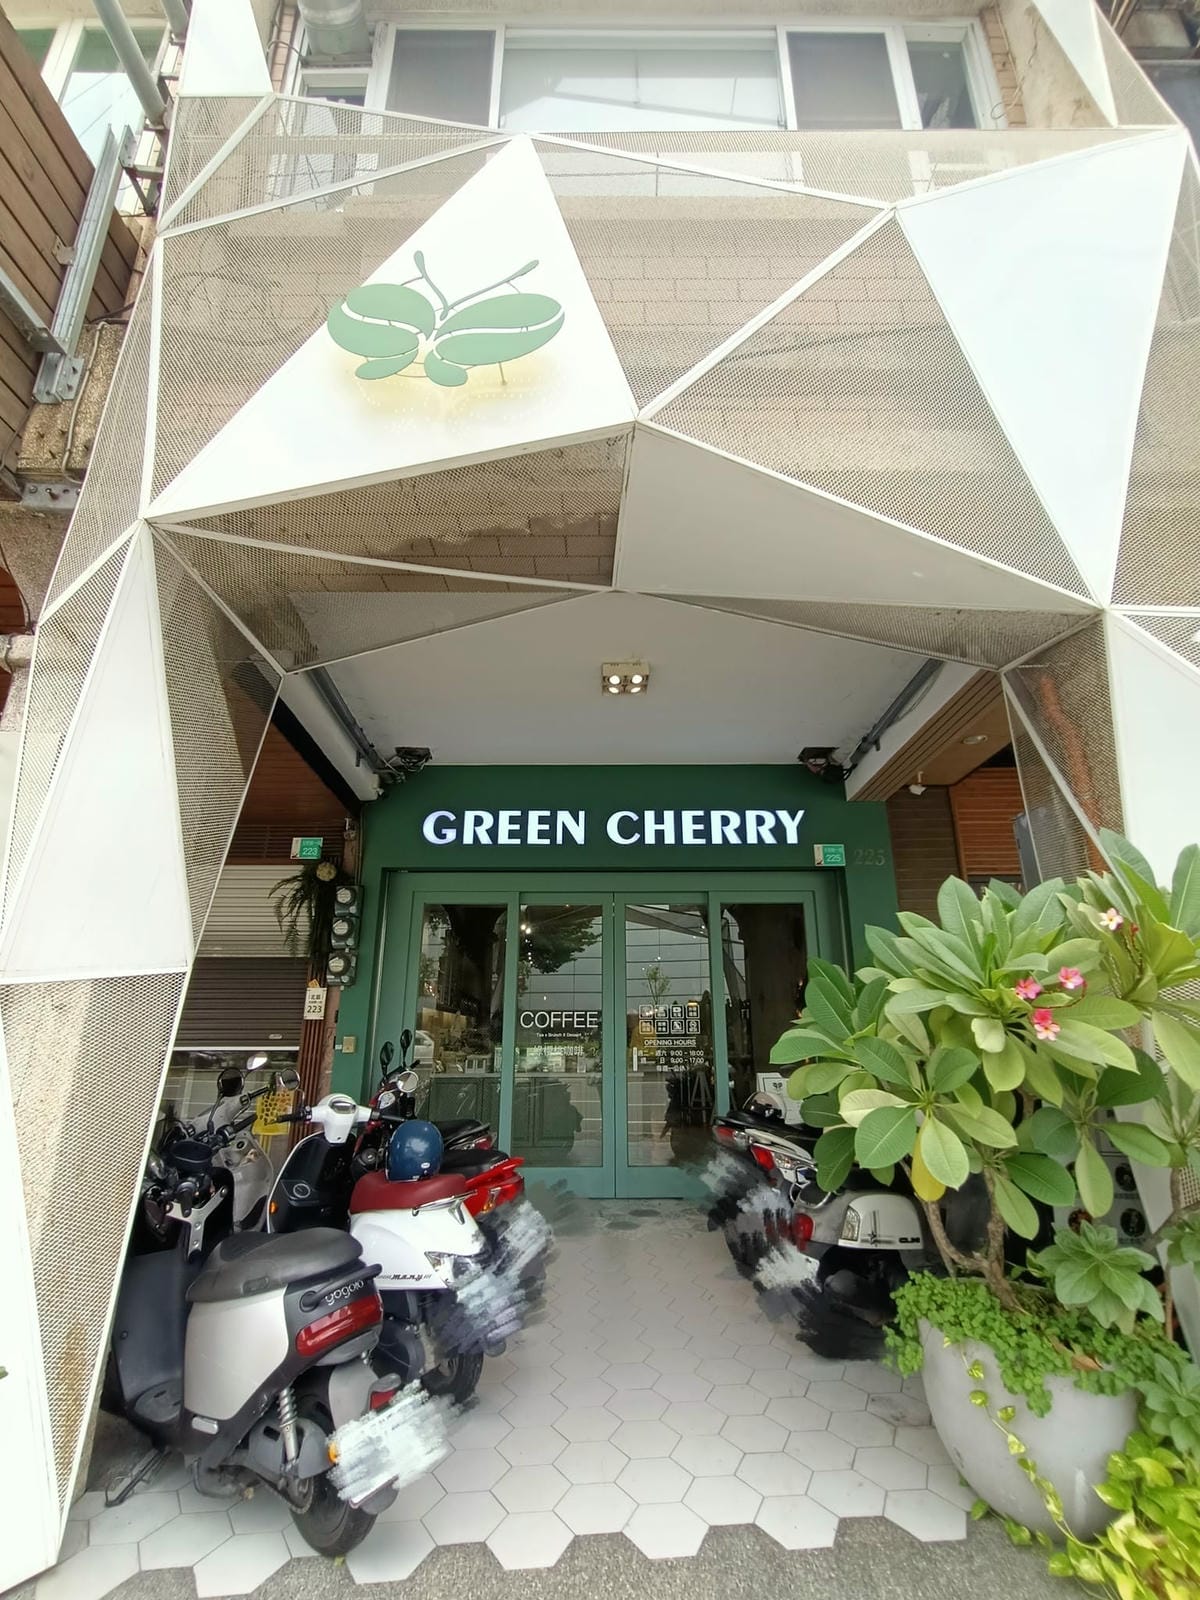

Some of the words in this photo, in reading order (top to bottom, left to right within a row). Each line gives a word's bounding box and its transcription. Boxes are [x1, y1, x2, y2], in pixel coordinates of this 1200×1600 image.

[422, 810, 585, 845] GREEN
[606, 810, 805, 845] CHERRY
[302, 847, 318, 856] 223
[825, 854, 841, 862] 225
[854, 849, 886, 866] 225
[307, 1005, 322, 1014] 223
[520, 1011, 599, 1028] COFFEE
